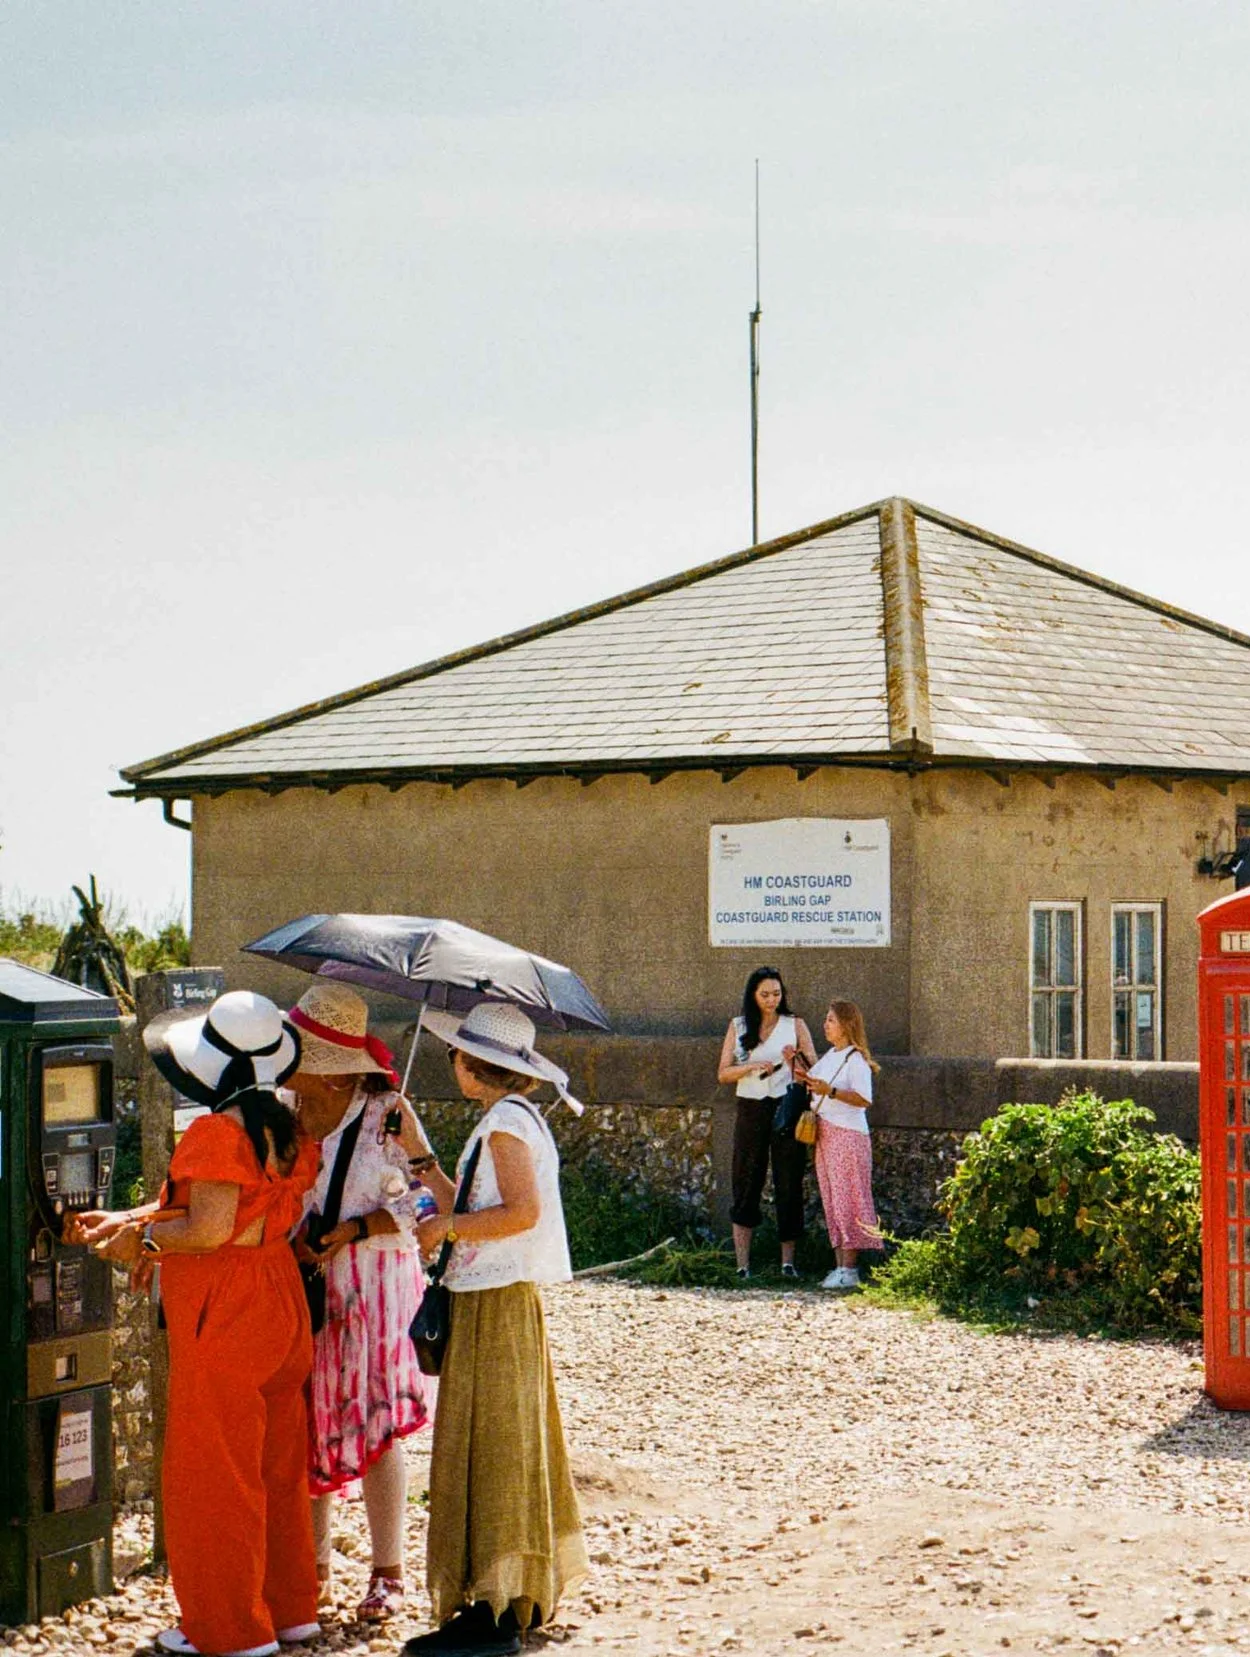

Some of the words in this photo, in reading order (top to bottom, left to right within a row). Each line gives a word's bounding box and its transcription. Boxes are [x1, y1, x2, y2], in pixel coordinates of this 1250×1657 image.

[744, 876, 762, 889] HM
[766, 875, 852, 889] COASTGUARD
[764, 895, 806, 906] BIRLING
[809, 895, 831, 906] GAP
[716, 911, 789, 923] COASTGUARD
[791, 911, 833, 922] RESCUE
[837, 911, 882, 922] STATION
[72, 1430, 88, 1444] 123
